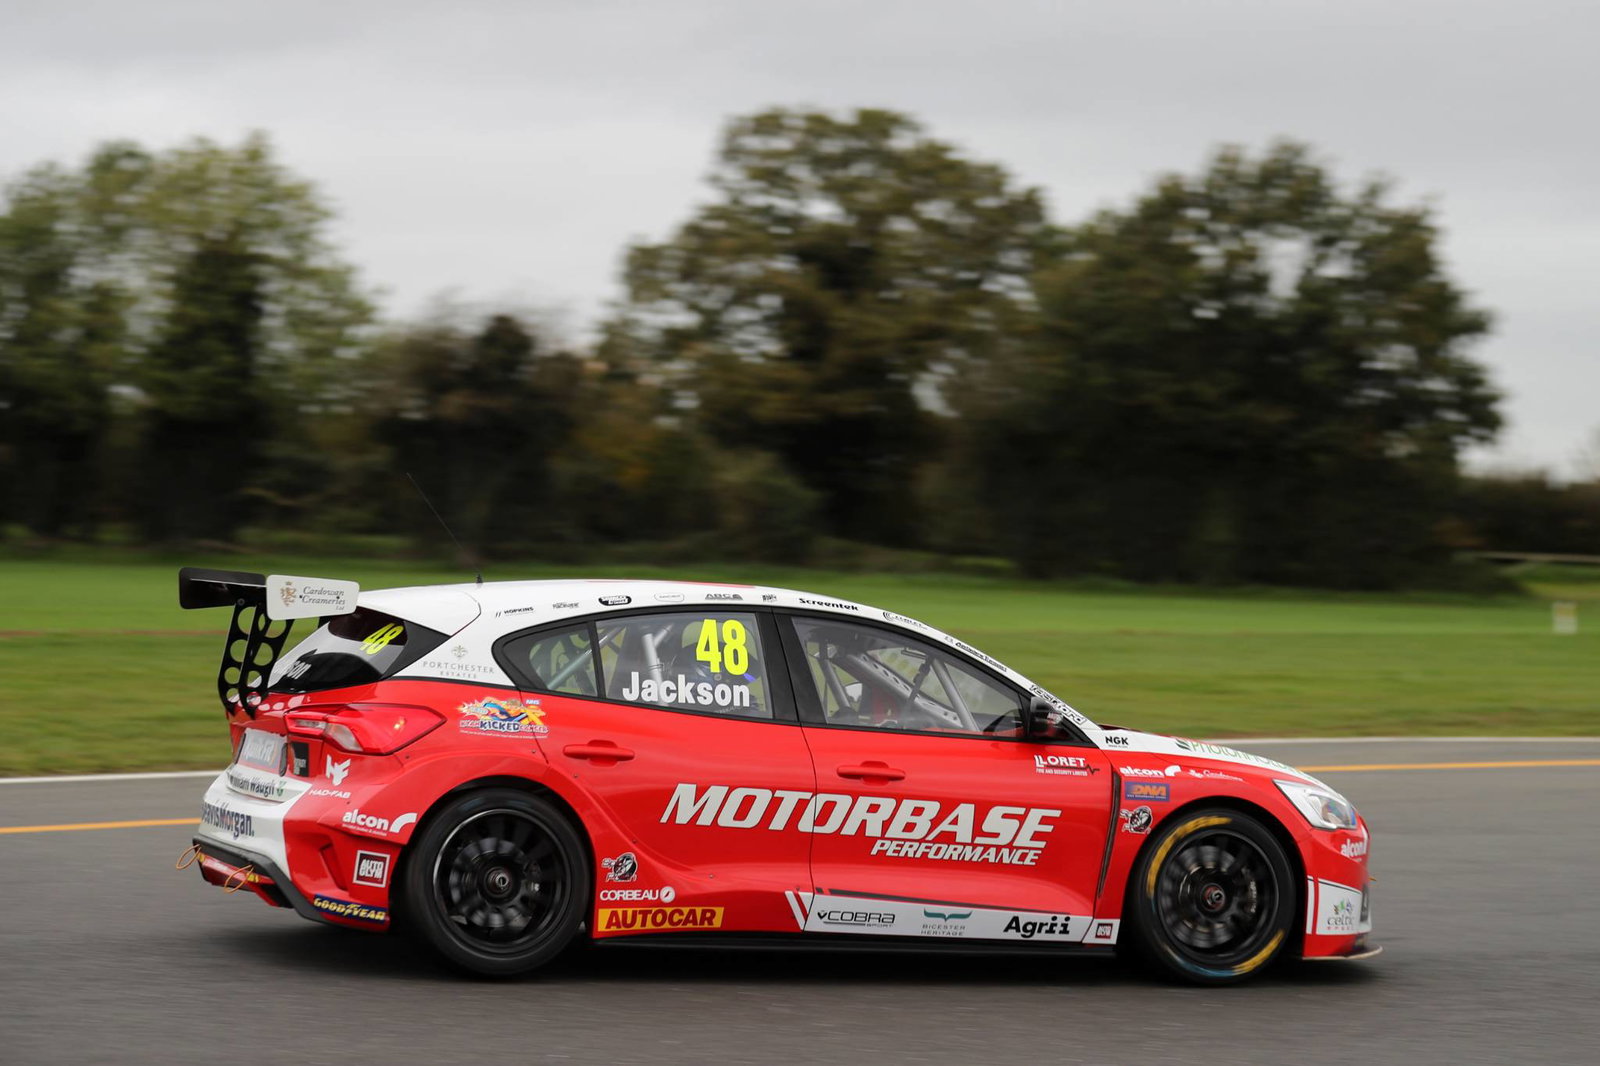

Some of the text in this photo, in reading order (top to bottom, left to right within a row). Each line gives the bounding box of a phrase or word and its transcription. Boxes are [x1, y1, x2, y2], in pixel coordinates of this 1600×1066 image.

[303, 586, 344, 596] Cardowan
[302, 595, 345, 605] Creameries
[799, 598, 859, 611] Screentek
[360, 622, 404, 655] 48
[696, 618, 749, 676] 48
[423, 661, 494, 674] PORTCHESTER
[622, 671, 750, 707] Jackson
[480, 720, 519, 732] KICKED
[1105, 736, 1129, 746] NGK
[1034, 755, 1086, 768] LLORET
[1120, 766, 1163, 776] alcon
[309, 789, 351, 799] HAD-FAB
[342, 809, 389, 831] alcon
[659, 782, 1062, 849] MOTORBASE
[870, 839, 1042, 866] PERFORMANCE
[360, 859, 384, 869] AUTO
[600, 889, 659, 901] CORBEAU
[313, 897, 386, 921] GOODYEAR
[605, 908, 716, 929] AUTOCAR
[1003, 915, 1071, 938] Agrii
